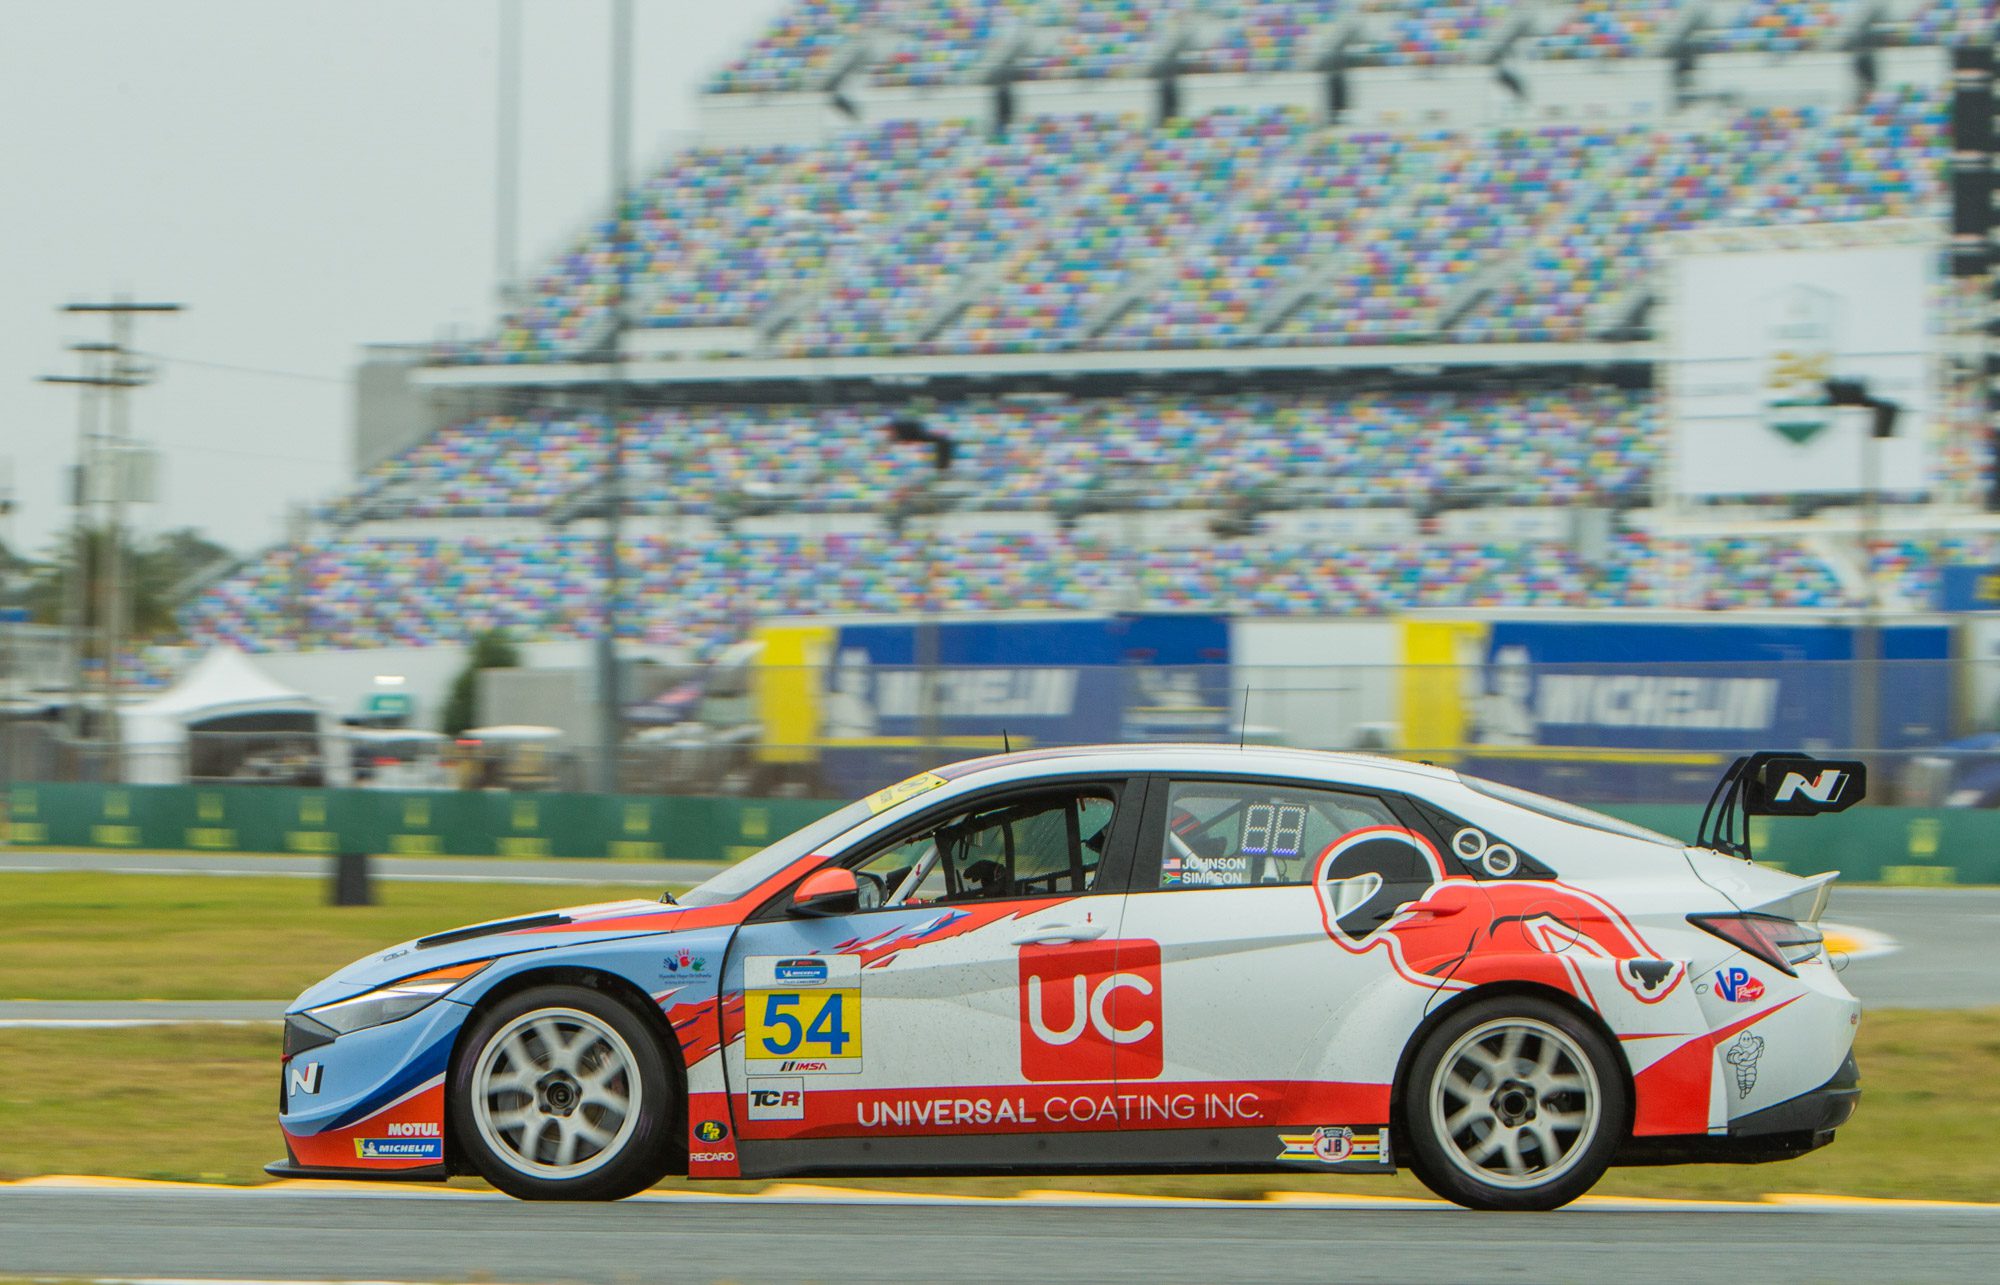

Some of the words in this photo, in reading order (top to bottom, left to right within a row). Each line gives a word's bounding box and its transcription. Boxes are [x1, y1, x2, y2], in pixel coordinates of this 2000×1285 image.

[1182, 858, 1246, 869] JOHNSON
[1182, 872, 1242, 884] SIMPSON
[1715, 967, 1749, 1002] VP
[1028, 973, 1154, 1045] UC
[762, 994, 850, 1054] 54
[795, 1063, 827, 1071] IMSA
[750, 1090, 801, 1107] TCR
[857, 1098, 1037, 1127] UNIVERSAL
[1043, 1094, 1195, 1122] COATING
[1204, 1092, 1264, 1119] INC.
[388, 1122, 440, 1136] MOTUL
[379, 1144, 435, 1153] MICHELIN
[689, 1152, 735, 1162] RECARO
